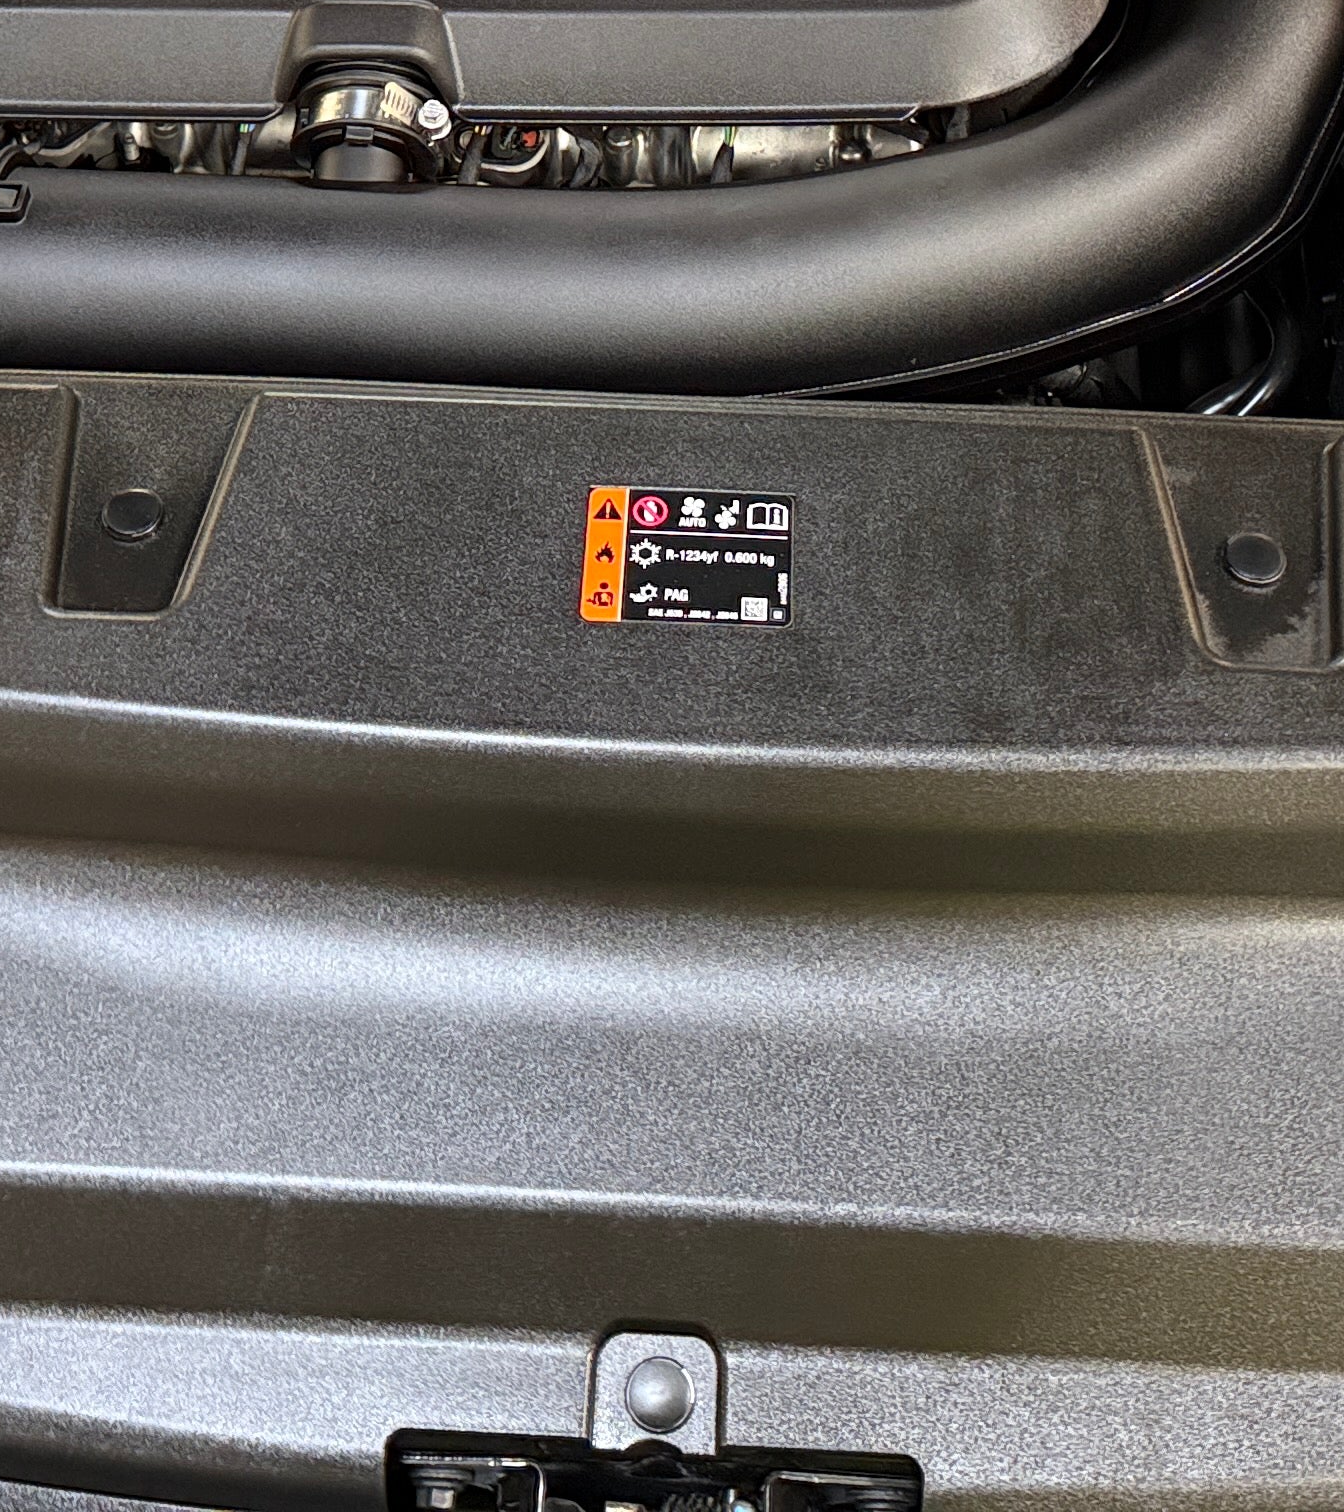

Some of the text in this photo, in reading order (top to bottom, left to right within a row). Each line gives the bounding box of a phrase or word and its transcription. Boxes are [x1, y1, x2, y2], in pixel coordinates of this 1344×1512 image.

[678, 516, 707, 528] AUTO
[665, 548, 775, 566] R-1234yf 0.600 kg
[664, 588, 689, 602] PAG
